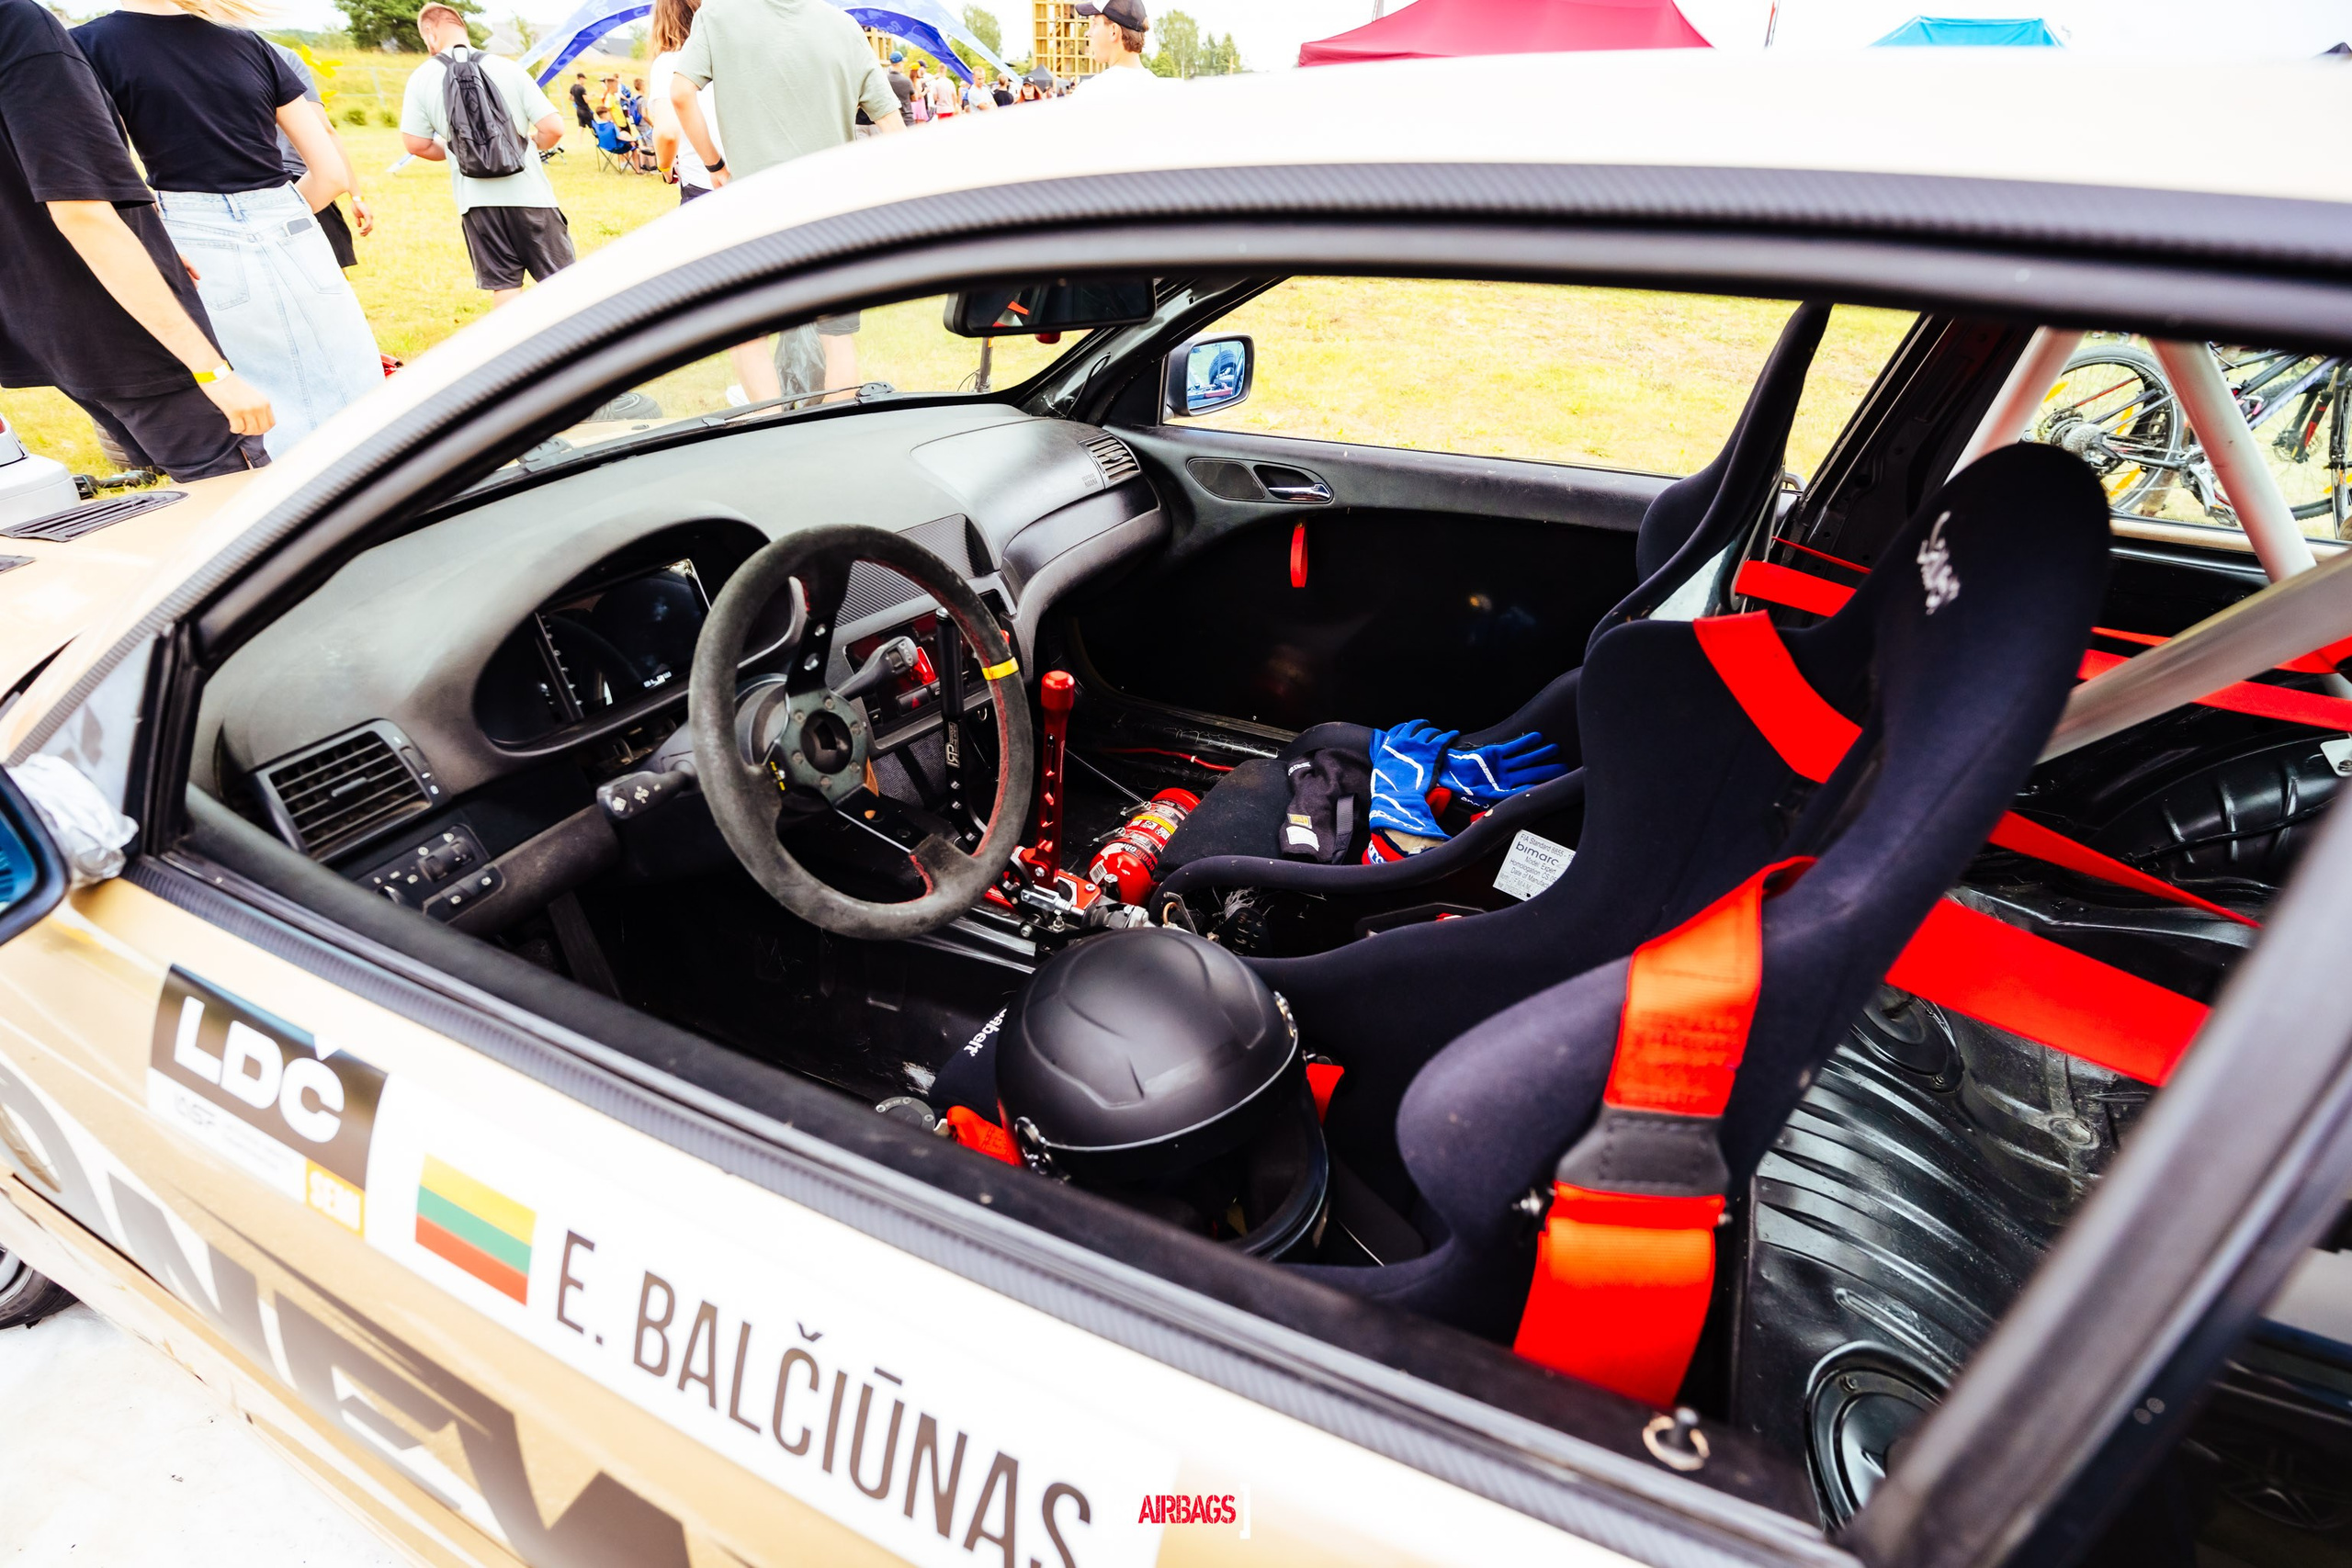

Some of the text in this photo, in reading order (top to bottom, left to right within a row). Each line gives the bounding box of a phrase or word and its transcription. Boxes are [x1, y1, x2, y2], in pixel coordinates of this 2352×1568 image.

[173, 994, 346, 1145] LDČ
[555, 1228, 1092, 1568] E. BALČIŪNAS
